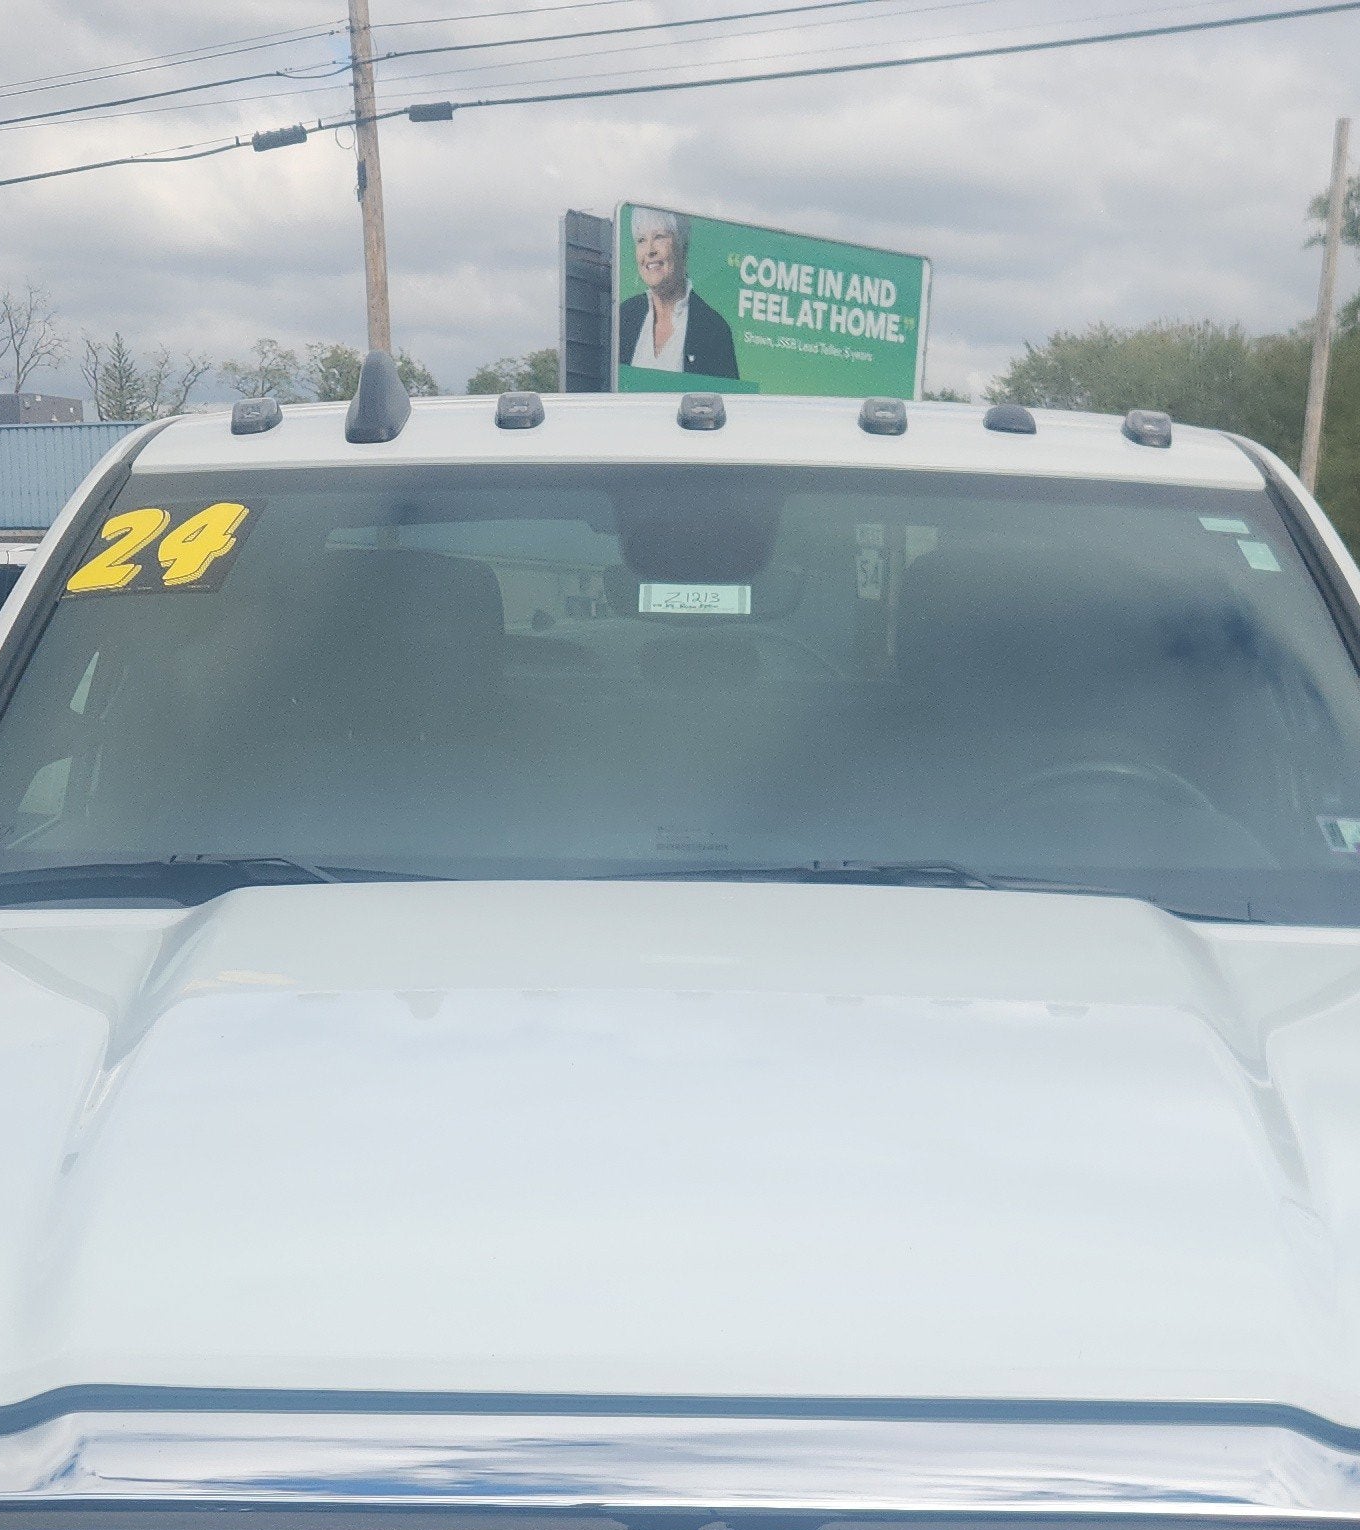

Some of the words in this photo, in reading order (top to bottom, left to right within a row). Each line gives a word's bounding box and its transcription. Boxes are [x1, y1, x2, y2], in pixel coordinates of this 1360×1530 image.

[818, 267, 841, 299] IN
[845, 273, 897, 308] AND
[738, 290, 795, 325] FEEL
[796, 300, 828, 330] AT
[67, 503, 249, 592] 24
